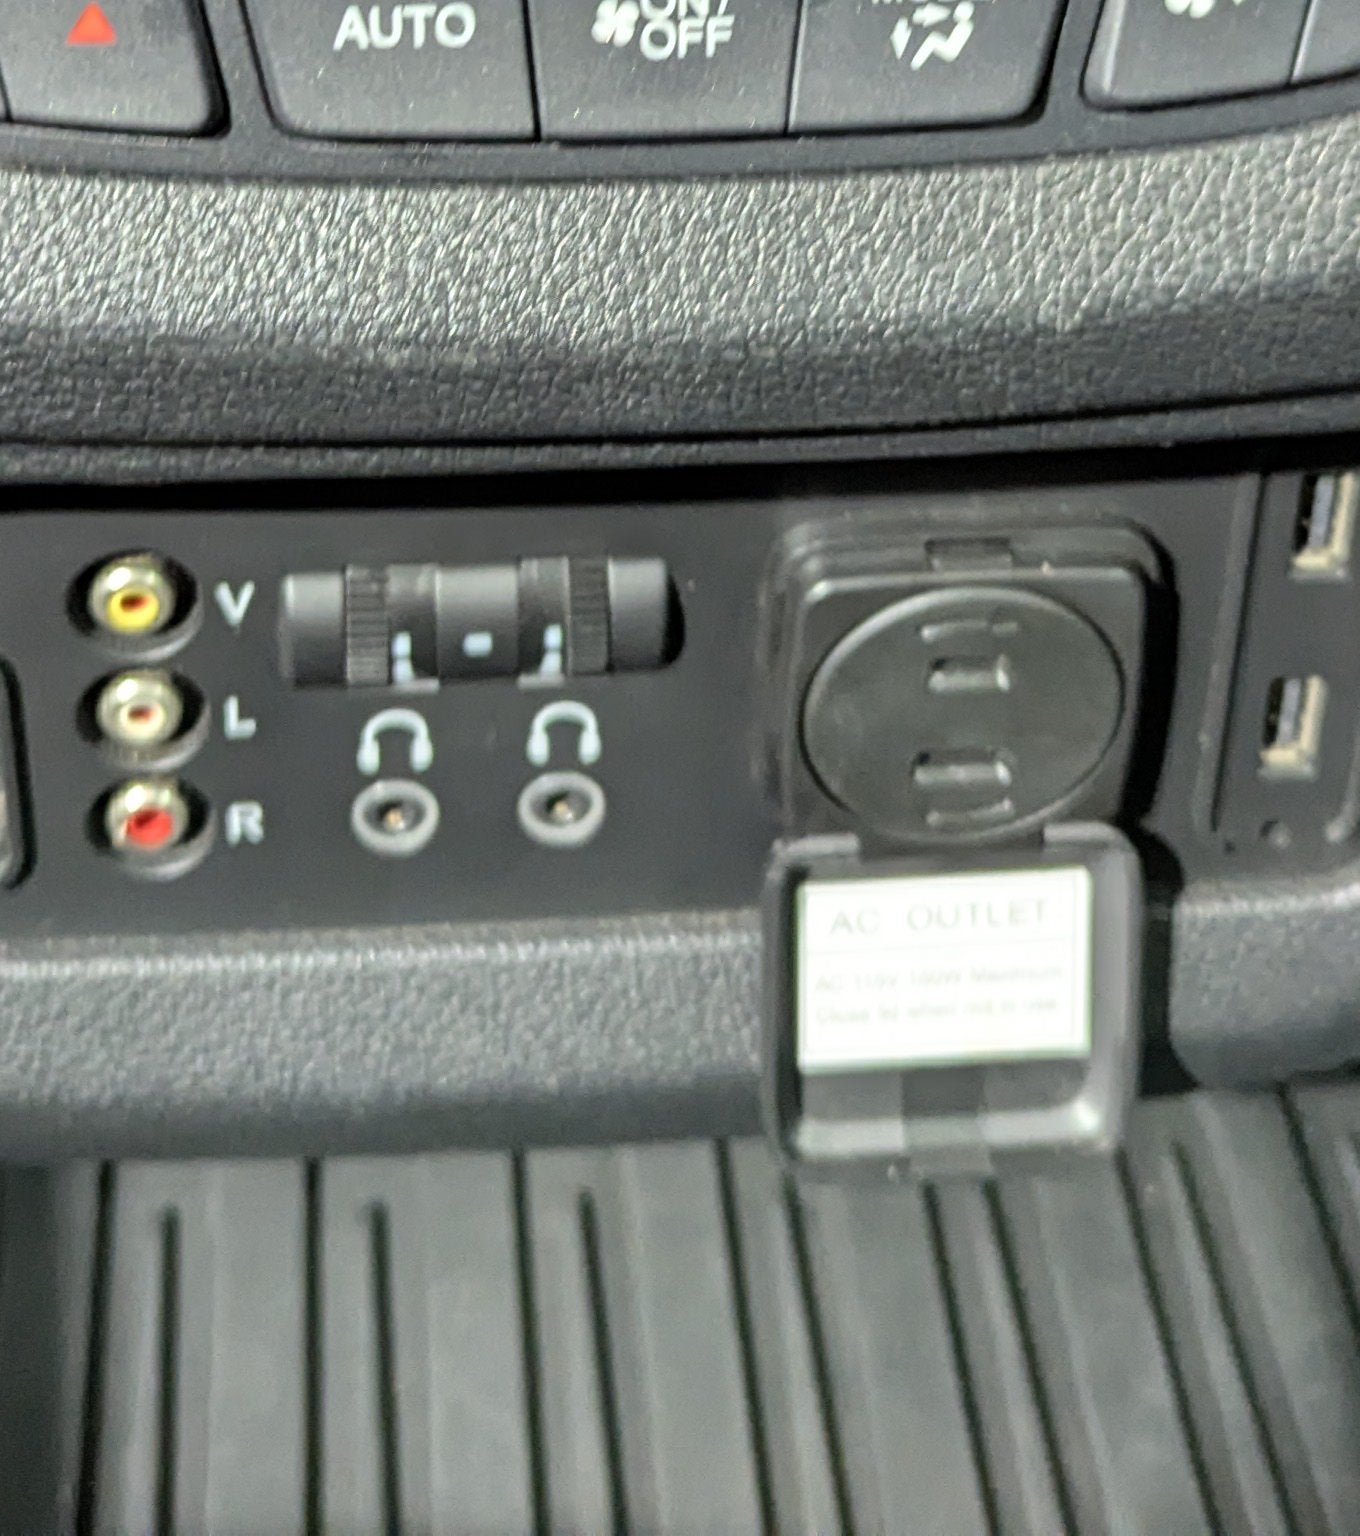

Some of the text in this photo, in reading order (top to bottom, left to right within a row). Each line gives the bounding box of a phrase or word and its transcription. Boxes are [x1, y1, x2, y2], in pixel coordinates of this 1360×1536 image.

[333, 1, 476, 50] AUTO
[639, 15, 735, 61] OFF
[214, 580, 255, 627] V
[223, 695, 257, 739] L
[224, 800, 264, 845] R
[830, 898, 1048, 935] AC OUTLET
